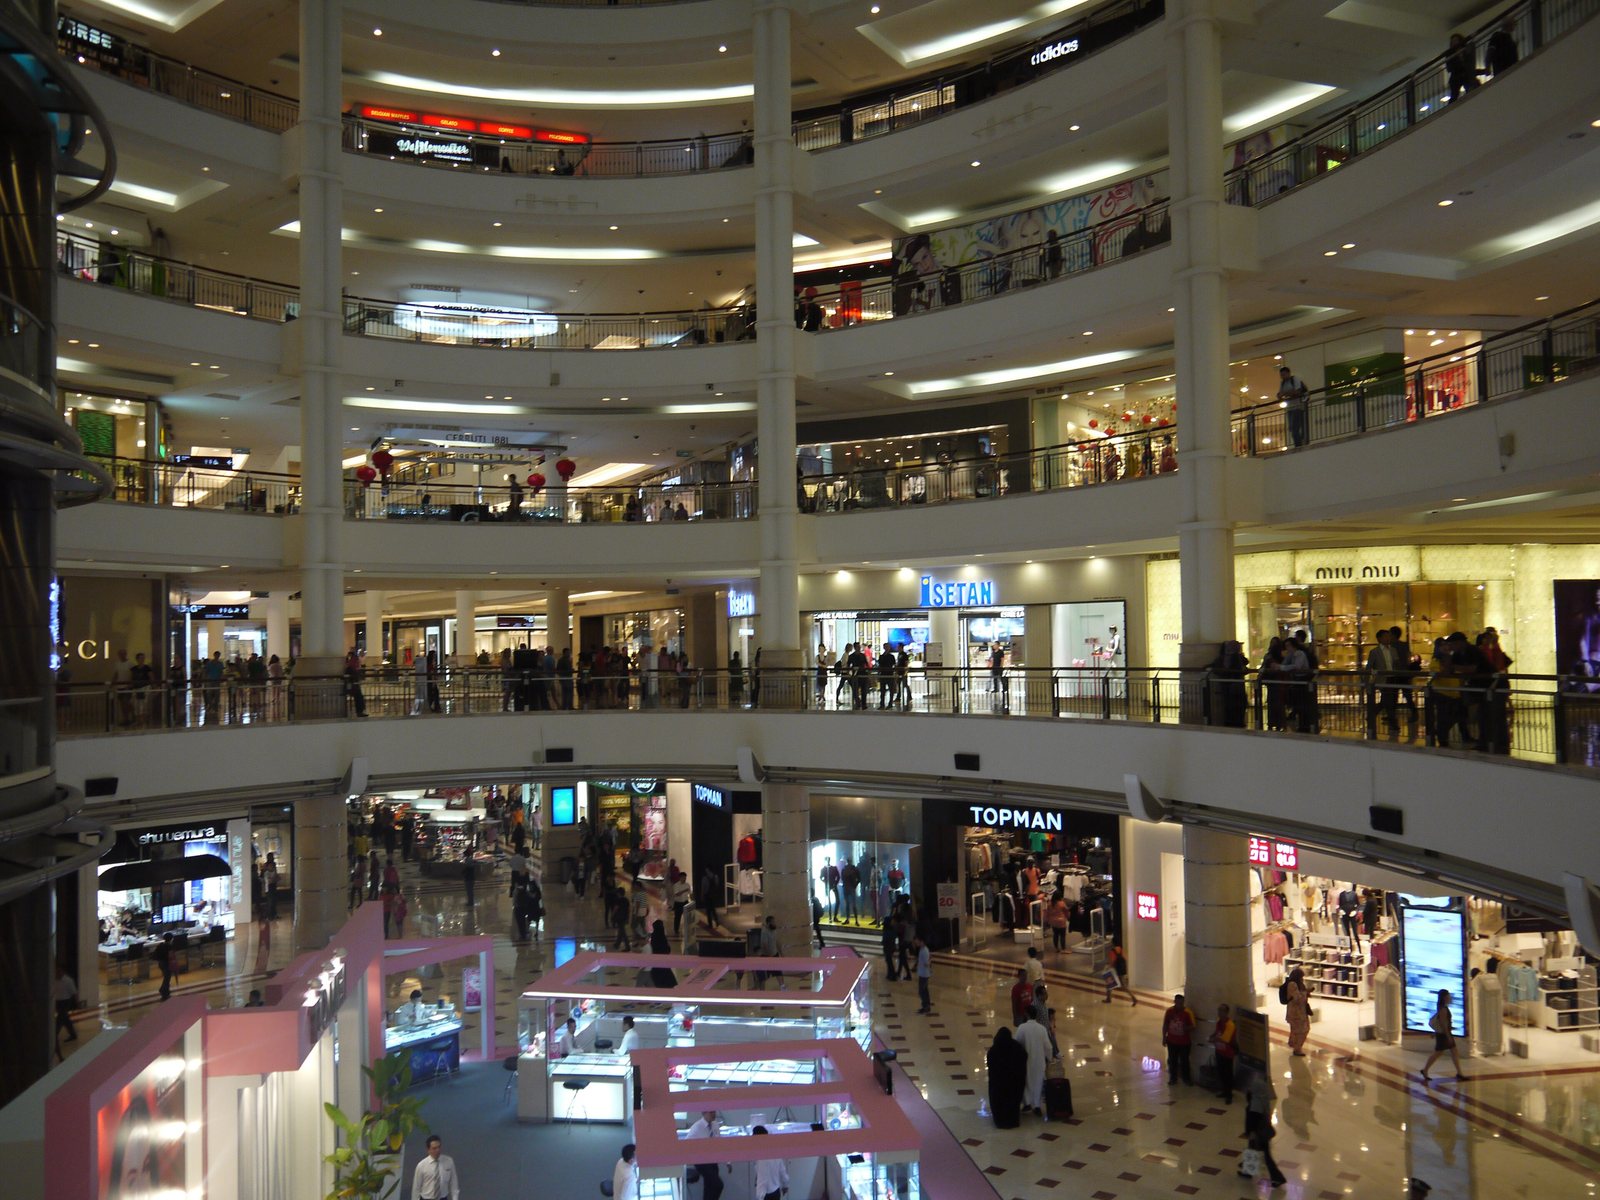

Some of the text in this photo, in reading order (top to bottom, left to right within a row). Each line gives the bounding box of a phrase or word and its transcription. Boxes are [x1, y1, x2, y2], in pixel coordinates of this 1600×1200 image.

[1031, 40, 1078, 65] adidas
[446, 434, 509, 445] CERRUTI 1881
[920, 575, 993, 607] ISETAN
[695, 784, 722, 807] TOPMAN
[970, 806, 1062, 831] TOPMAN
[139, 833, 163, 845] shu
[166, 827, 215, 841] uemura
